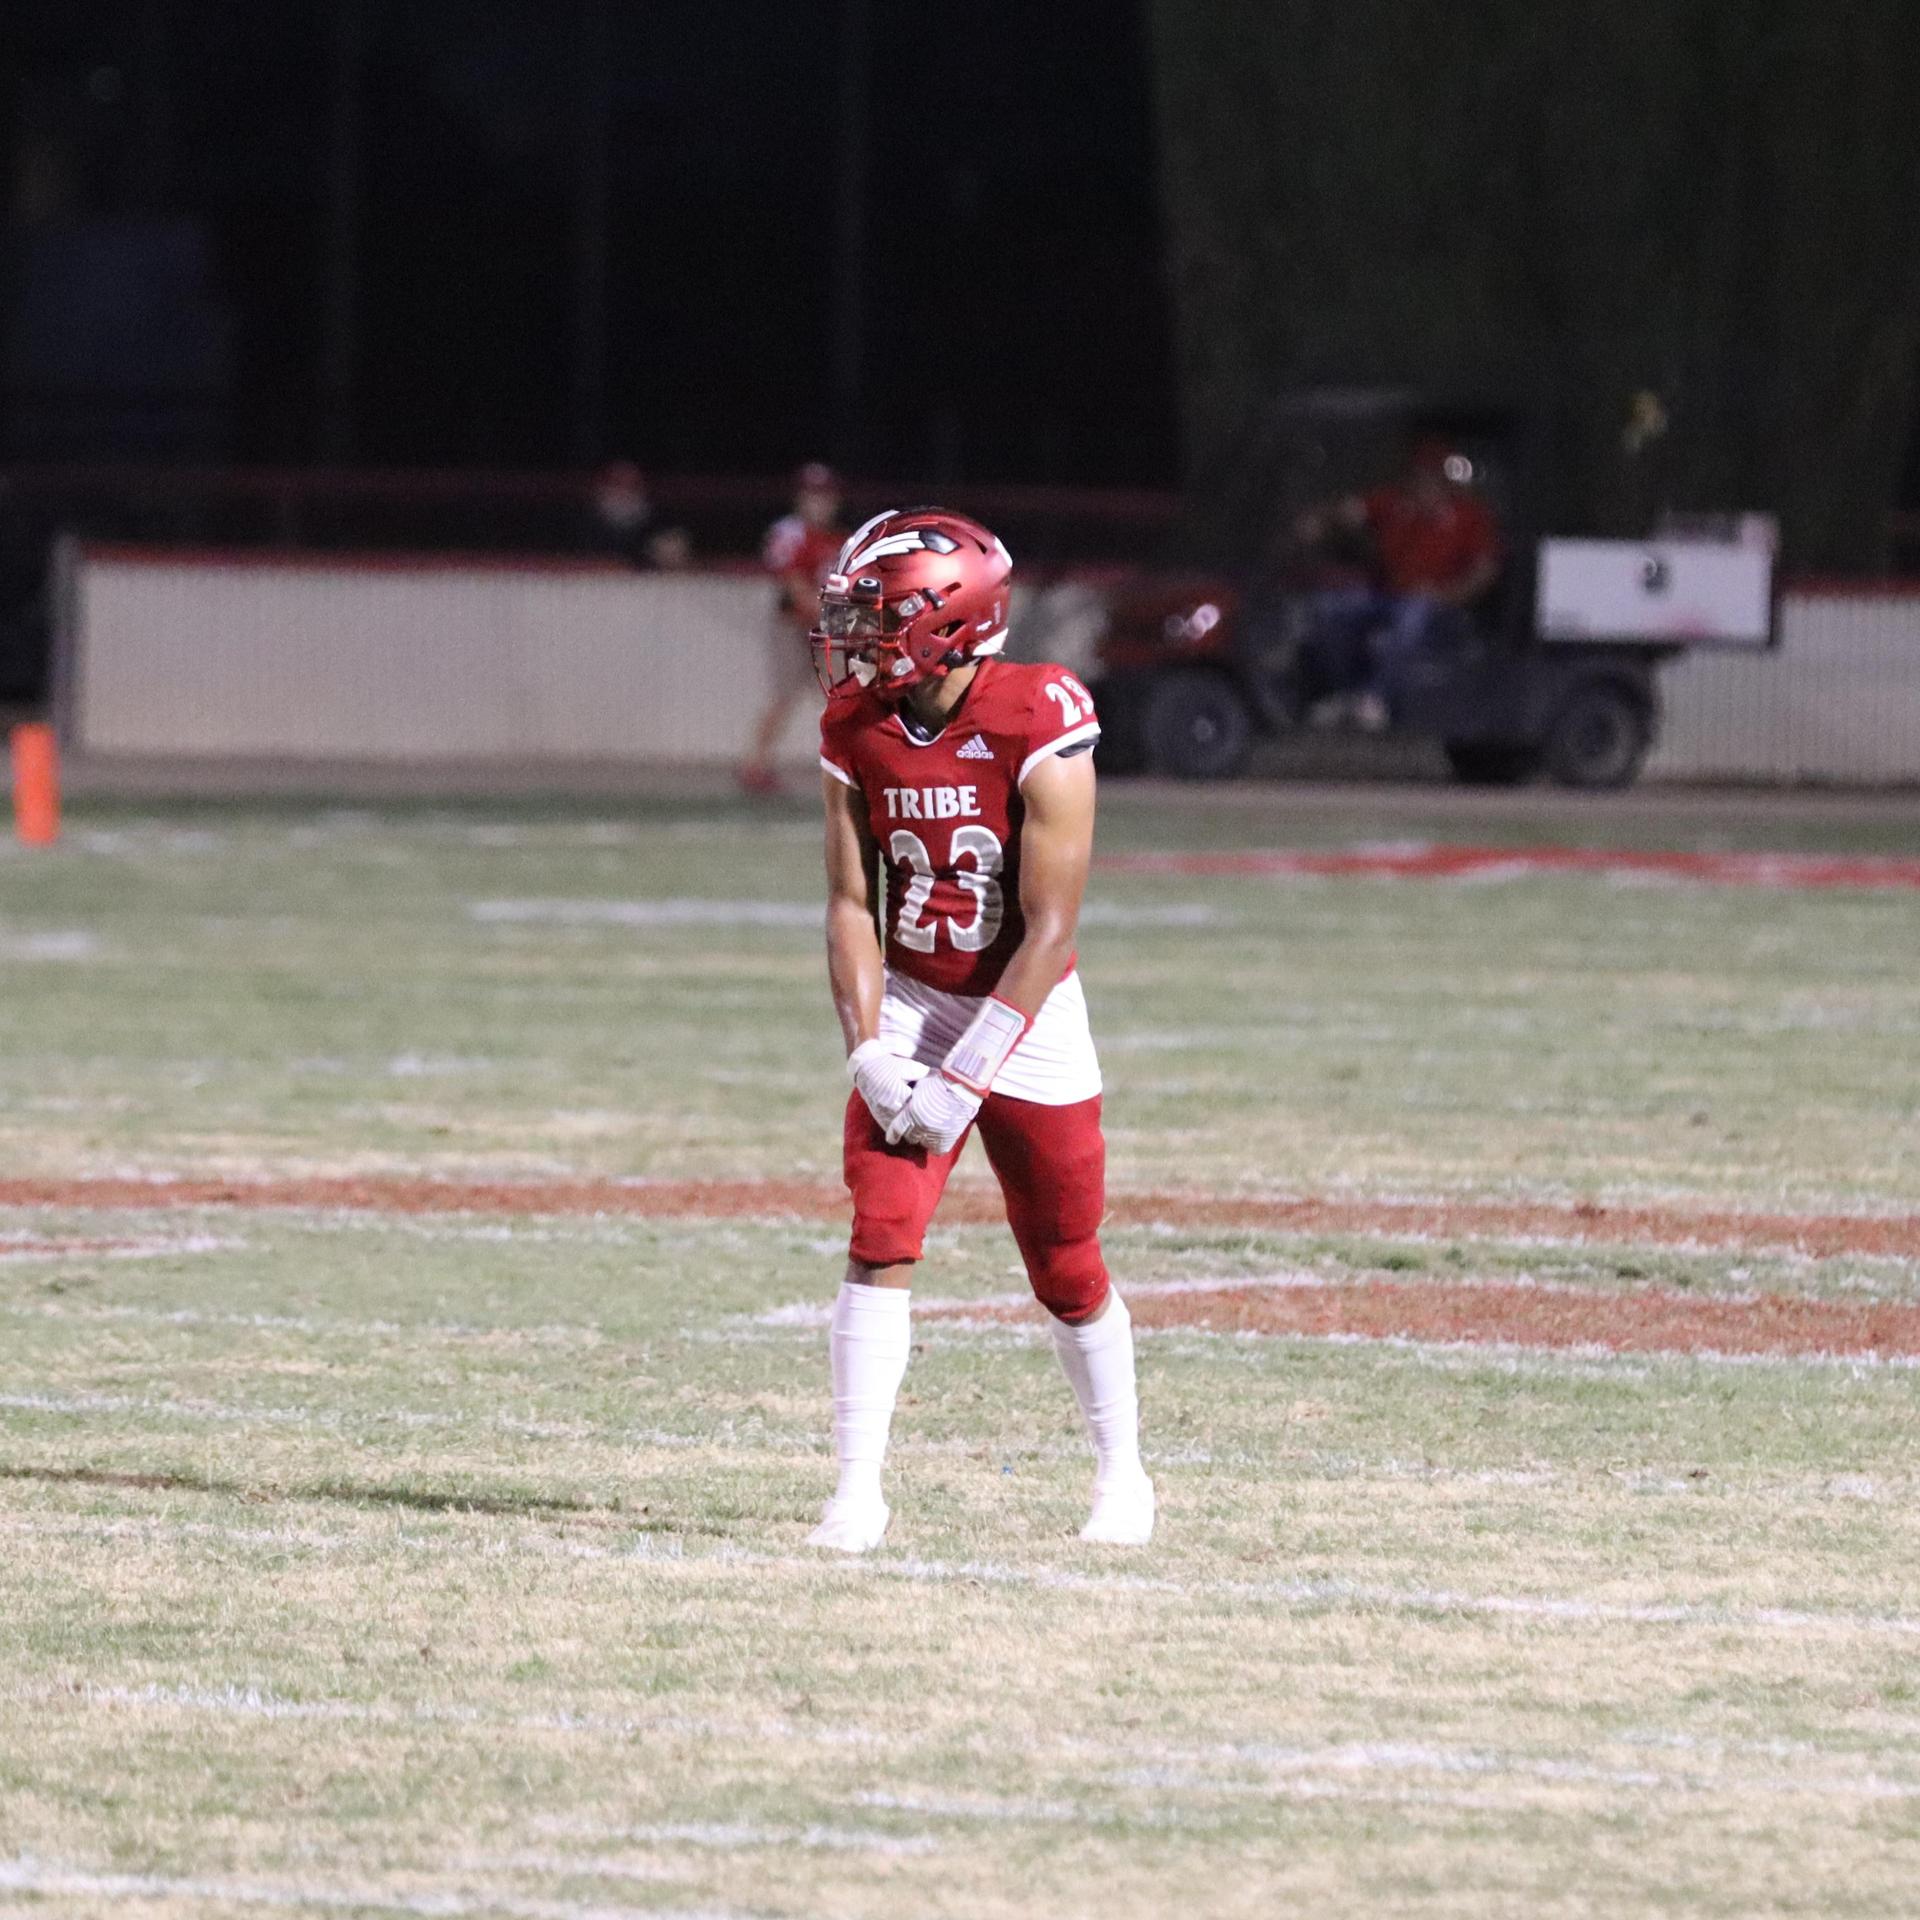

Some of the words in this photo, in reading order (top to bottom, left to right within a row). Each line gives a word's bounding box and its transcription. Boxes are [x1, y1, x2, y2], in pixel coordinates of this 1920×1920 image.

[1045, 675, 1094, 728] 23
[956, 749, 994, 760] adidas
[883, 785, 981, 819] TRIBE
[889, 825, 1004, 953] 23
